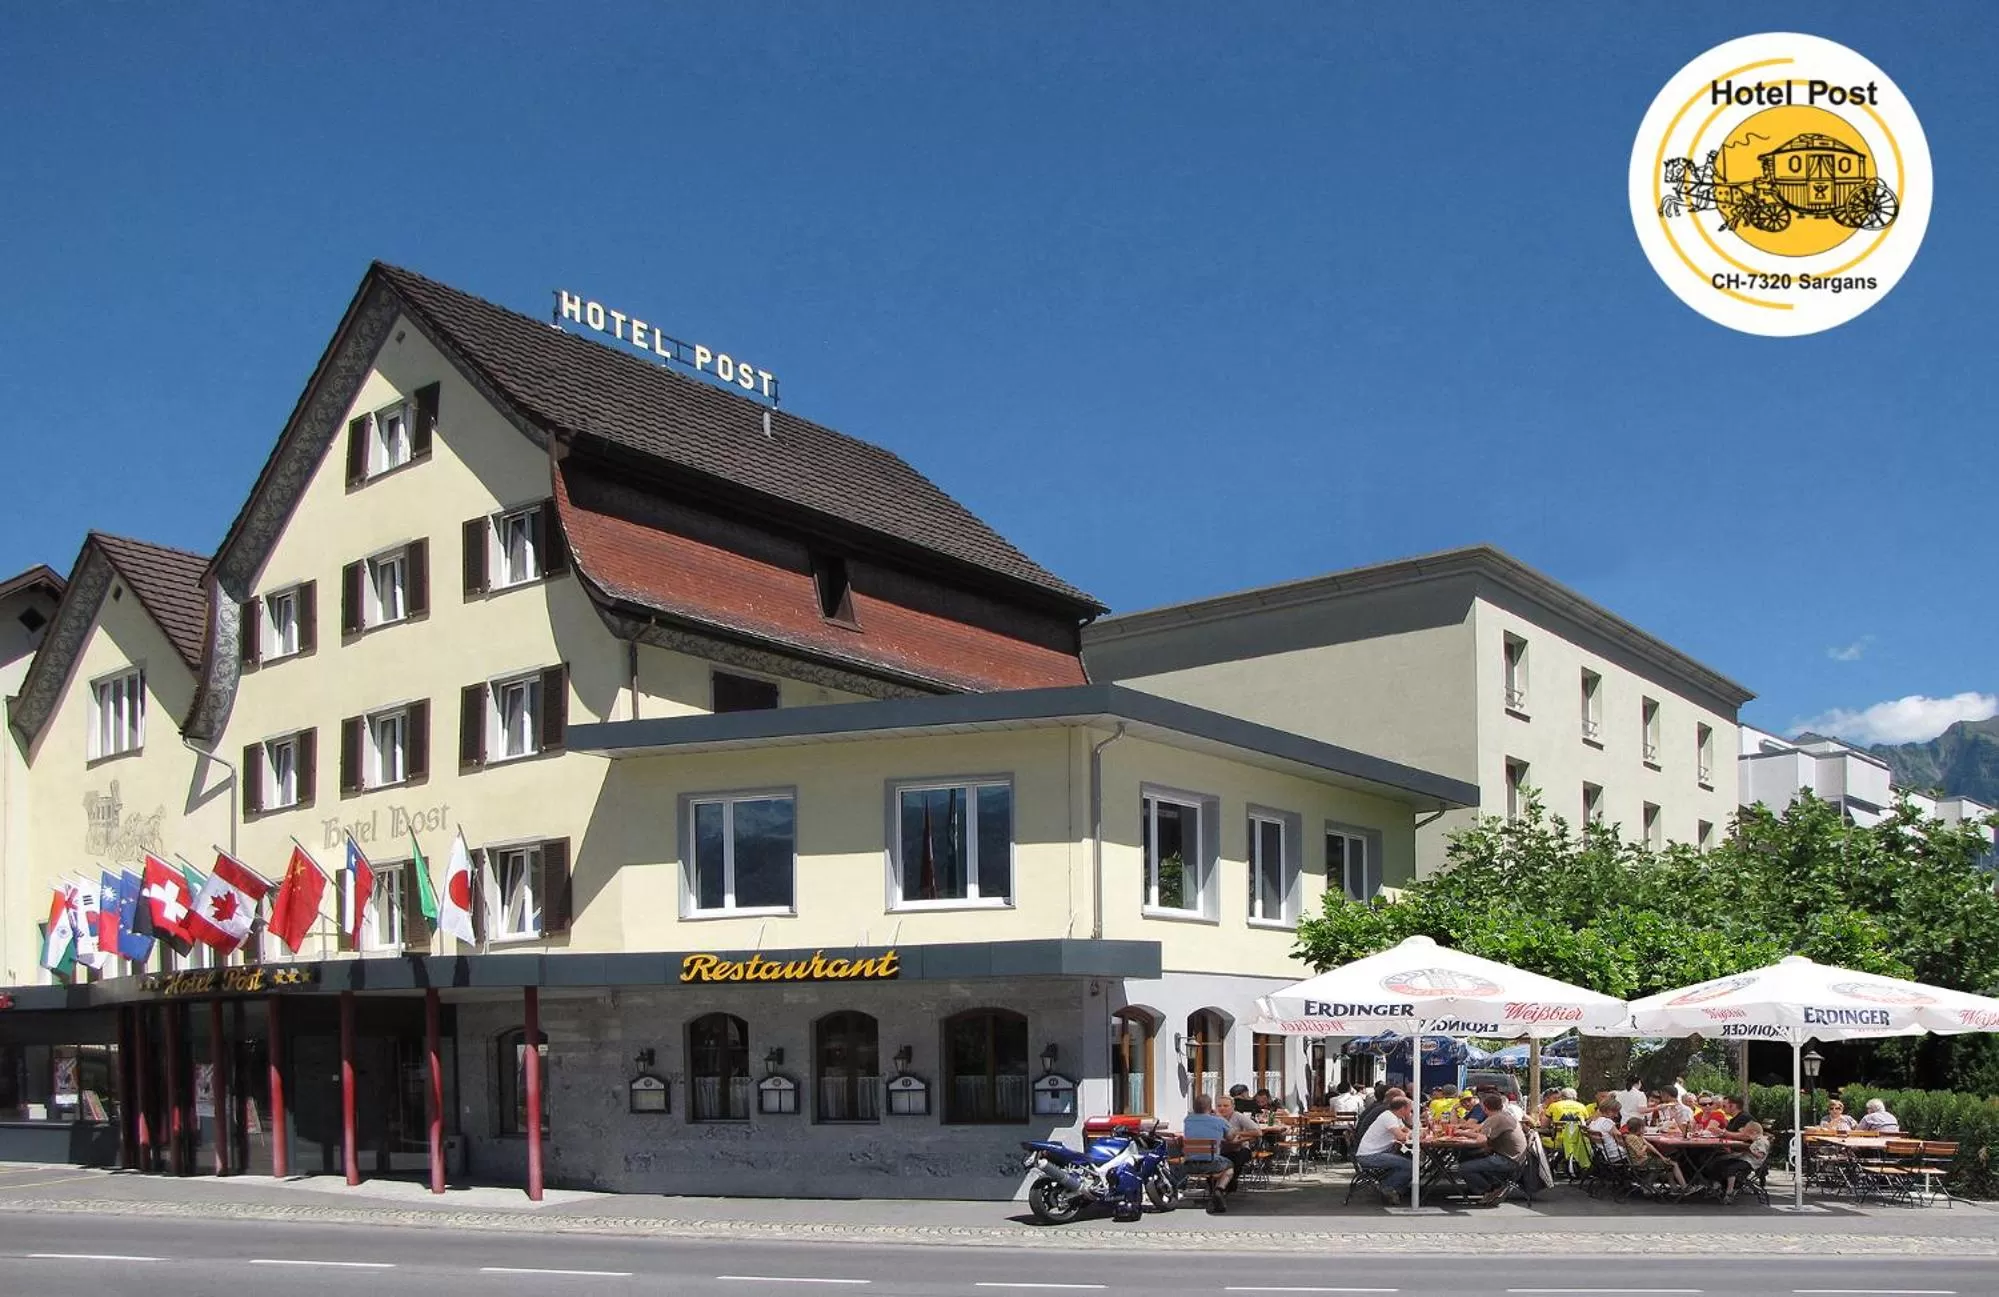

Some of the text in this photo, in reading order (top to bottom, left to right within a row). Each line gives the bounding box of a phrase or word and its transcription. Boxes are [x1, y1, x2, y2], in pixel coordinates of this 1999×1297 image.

[561, 290, 773, 397] HOTEL POST
[320, 800, 451, 850] Hotel Post
[164, 966, 265, 995] Hotel Post
[680, 949, 901, 984] Restaurant
[1304, 1000, 1415, 1017] ERDINGER
[1503, 1002, 1583, 1024] Weißbier
[1803, 1006, 1891, 1026] ERDINGER
